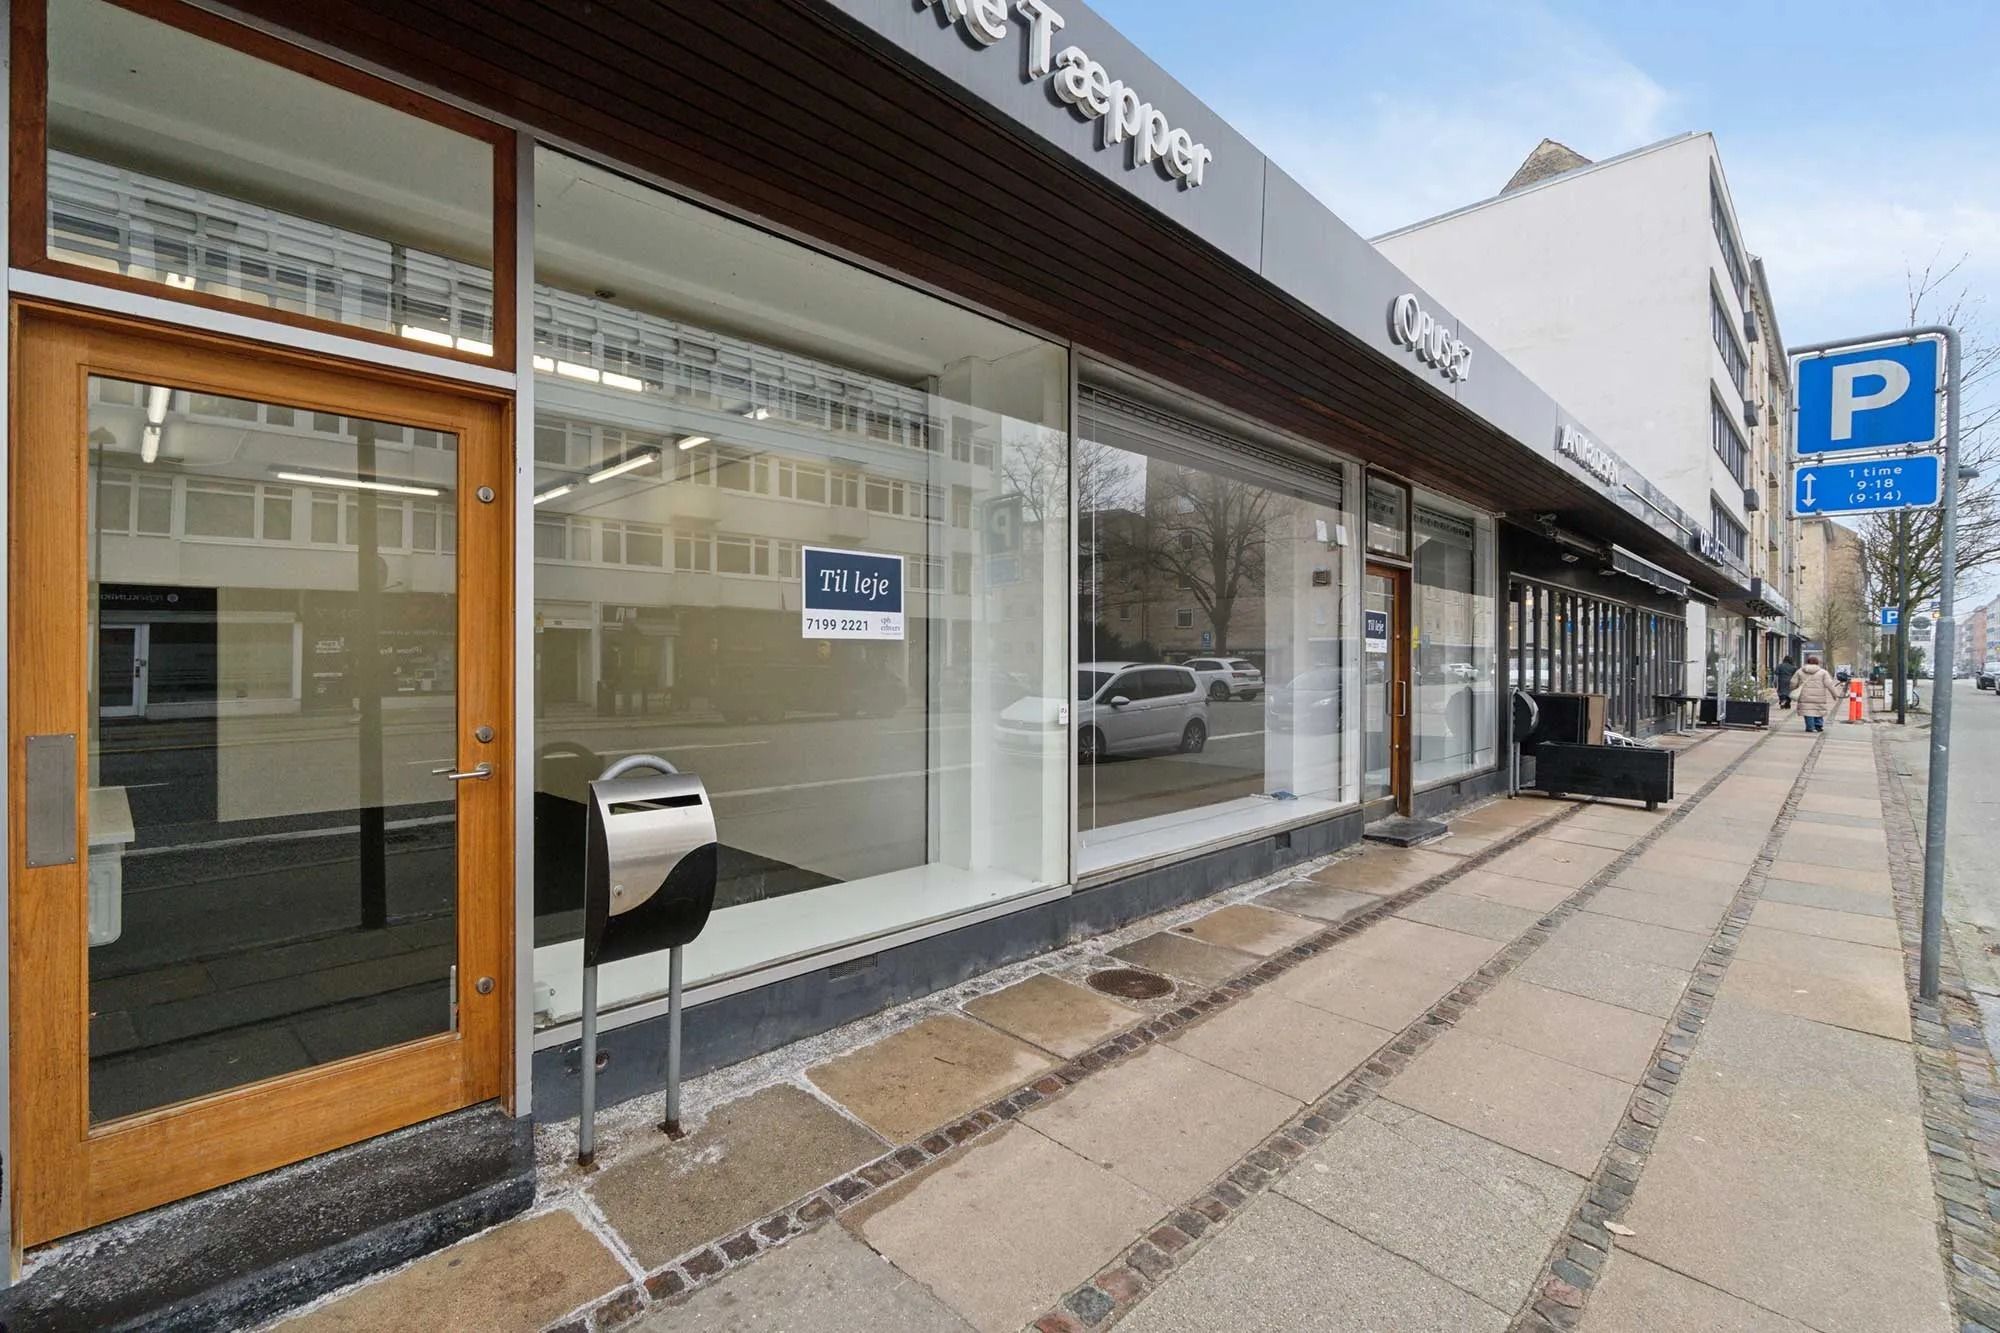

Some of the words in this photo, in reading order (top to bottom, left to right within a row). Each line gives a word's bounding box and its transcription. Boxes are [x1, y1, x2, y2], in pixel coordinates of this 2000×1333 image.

[1017, 0, 1212, 189] Tæpper
[1830, 359, 1911, 441] P
[1849, 469, 1855, 478] 1
[1863, 466, 1903, 478] time
[820, 569, 848, 592] Til
[854, 570, 889, 601] leje
[806, 618, 837, 630] 7199
[841, 619, 869, 631] 2221
[1886, 610, 1899, 624] P
